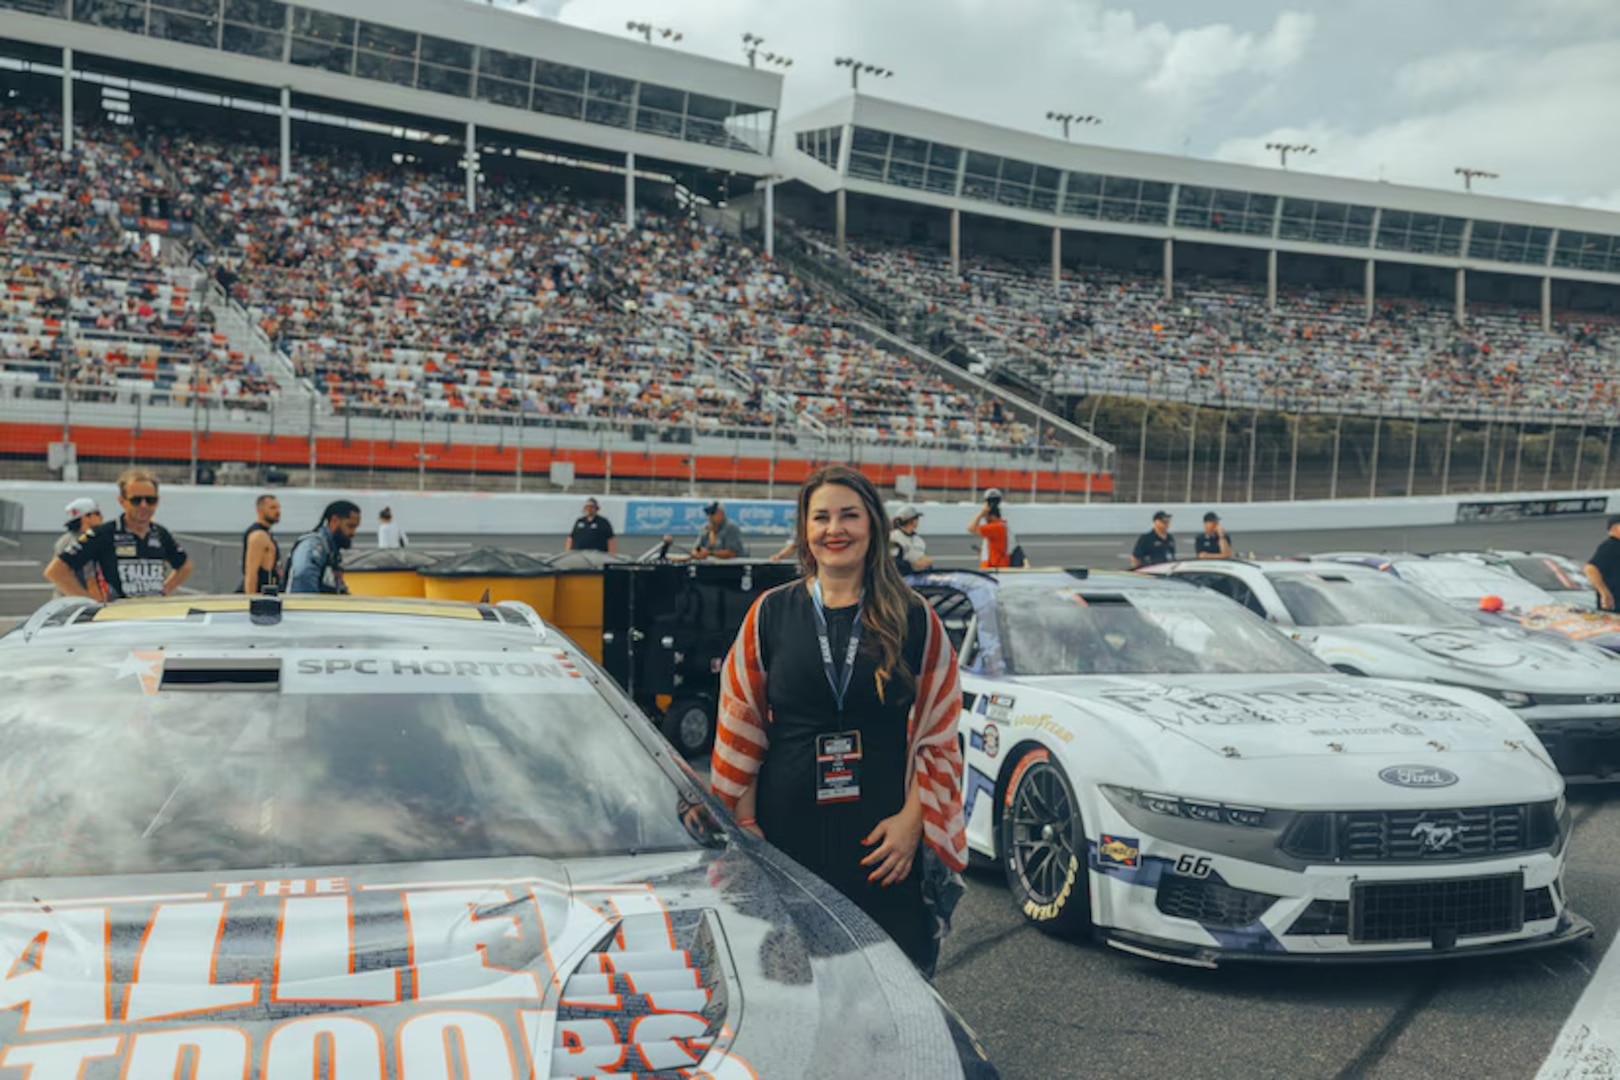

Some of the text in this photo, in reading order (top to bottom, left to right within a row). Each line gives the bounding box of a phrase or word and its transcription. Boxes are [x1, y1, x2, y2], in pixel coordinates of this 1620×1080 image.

[297, 658, 563, 678] SPC HORTON
[1397, 767, 1445, 784] Ford
[1174, 853, 1212, 879] 66
[210, 876, 349, 899] THE
